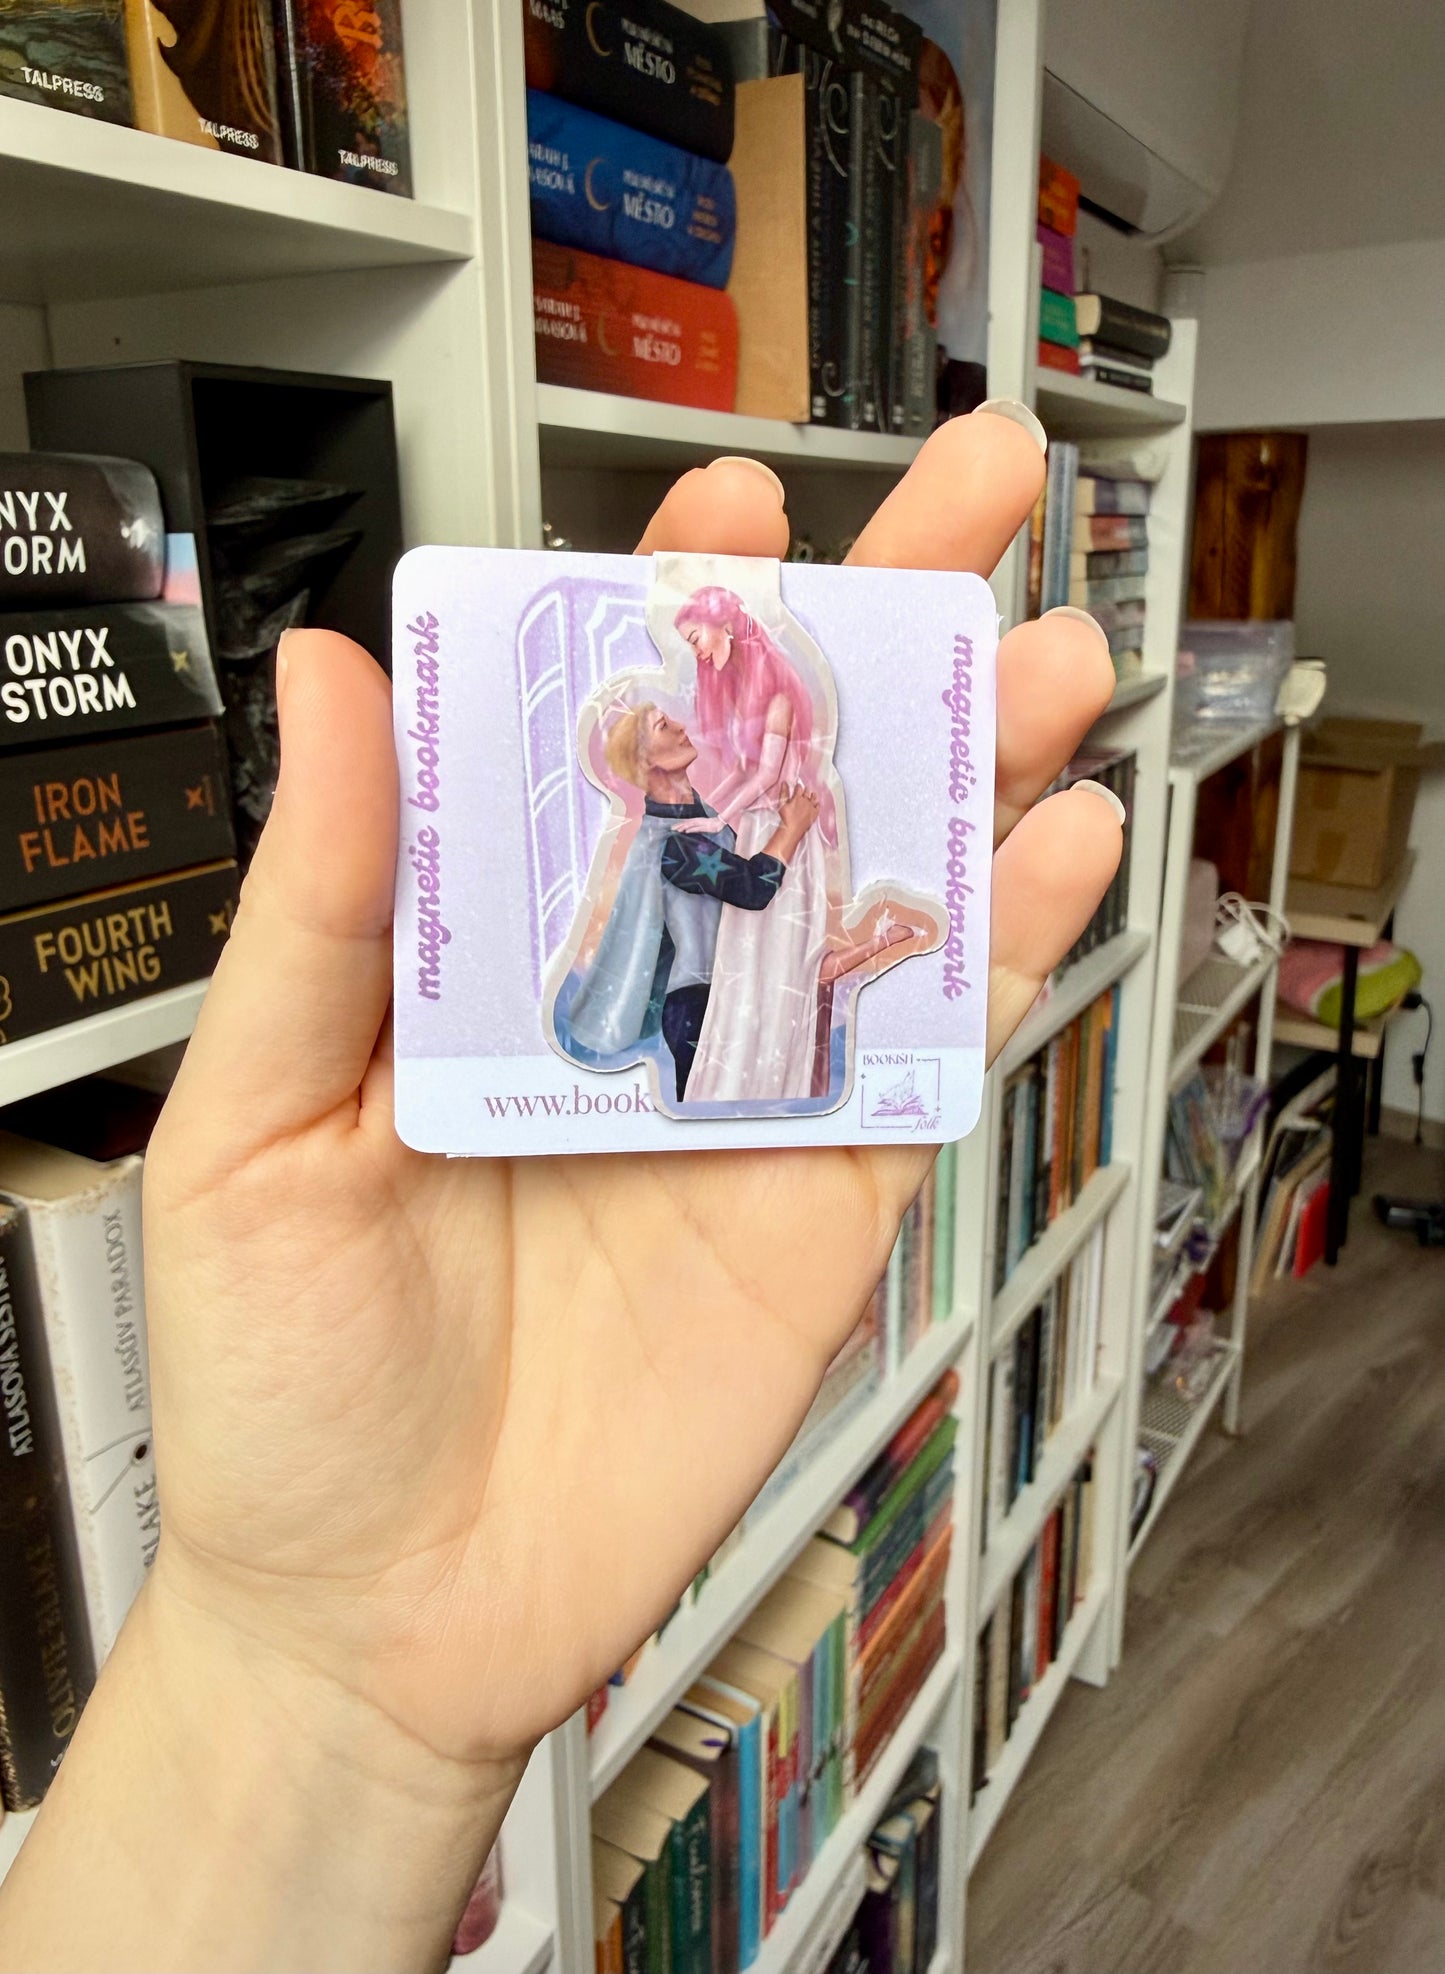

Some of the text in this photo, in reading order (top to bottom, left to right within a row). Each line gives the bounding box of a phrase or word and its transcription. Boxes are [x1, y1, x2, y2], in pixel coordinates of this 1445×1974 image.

[19, 66, 105, 103] TALPRESS
[198, 117, 260, 150] TALPRESS
[337, 149, 399, 177] TALPRESS
[4, 535, 87, 575] ORM
[5, 627, 115, 676] ONYX
[1, 672, 137, 723] STORM
[407, 611, 440, 812] bookmark
[940, 633, 977, 804] magnetic
[33, 773, 123, 825] IRON
[19, 810, 150, 873] FLAME
[407, 824, 452, 1001] magnetic
[942, 816, 976, 1002] bookmark
[34, 901, 174, 973] FOURTH
[64, 945, 161, 1003] WING
[863, 1052, 914, 1066] BOOKISH
[911, 1115, 942, 1134] folk
[103, 1208, 135, 1319] PARADOX
